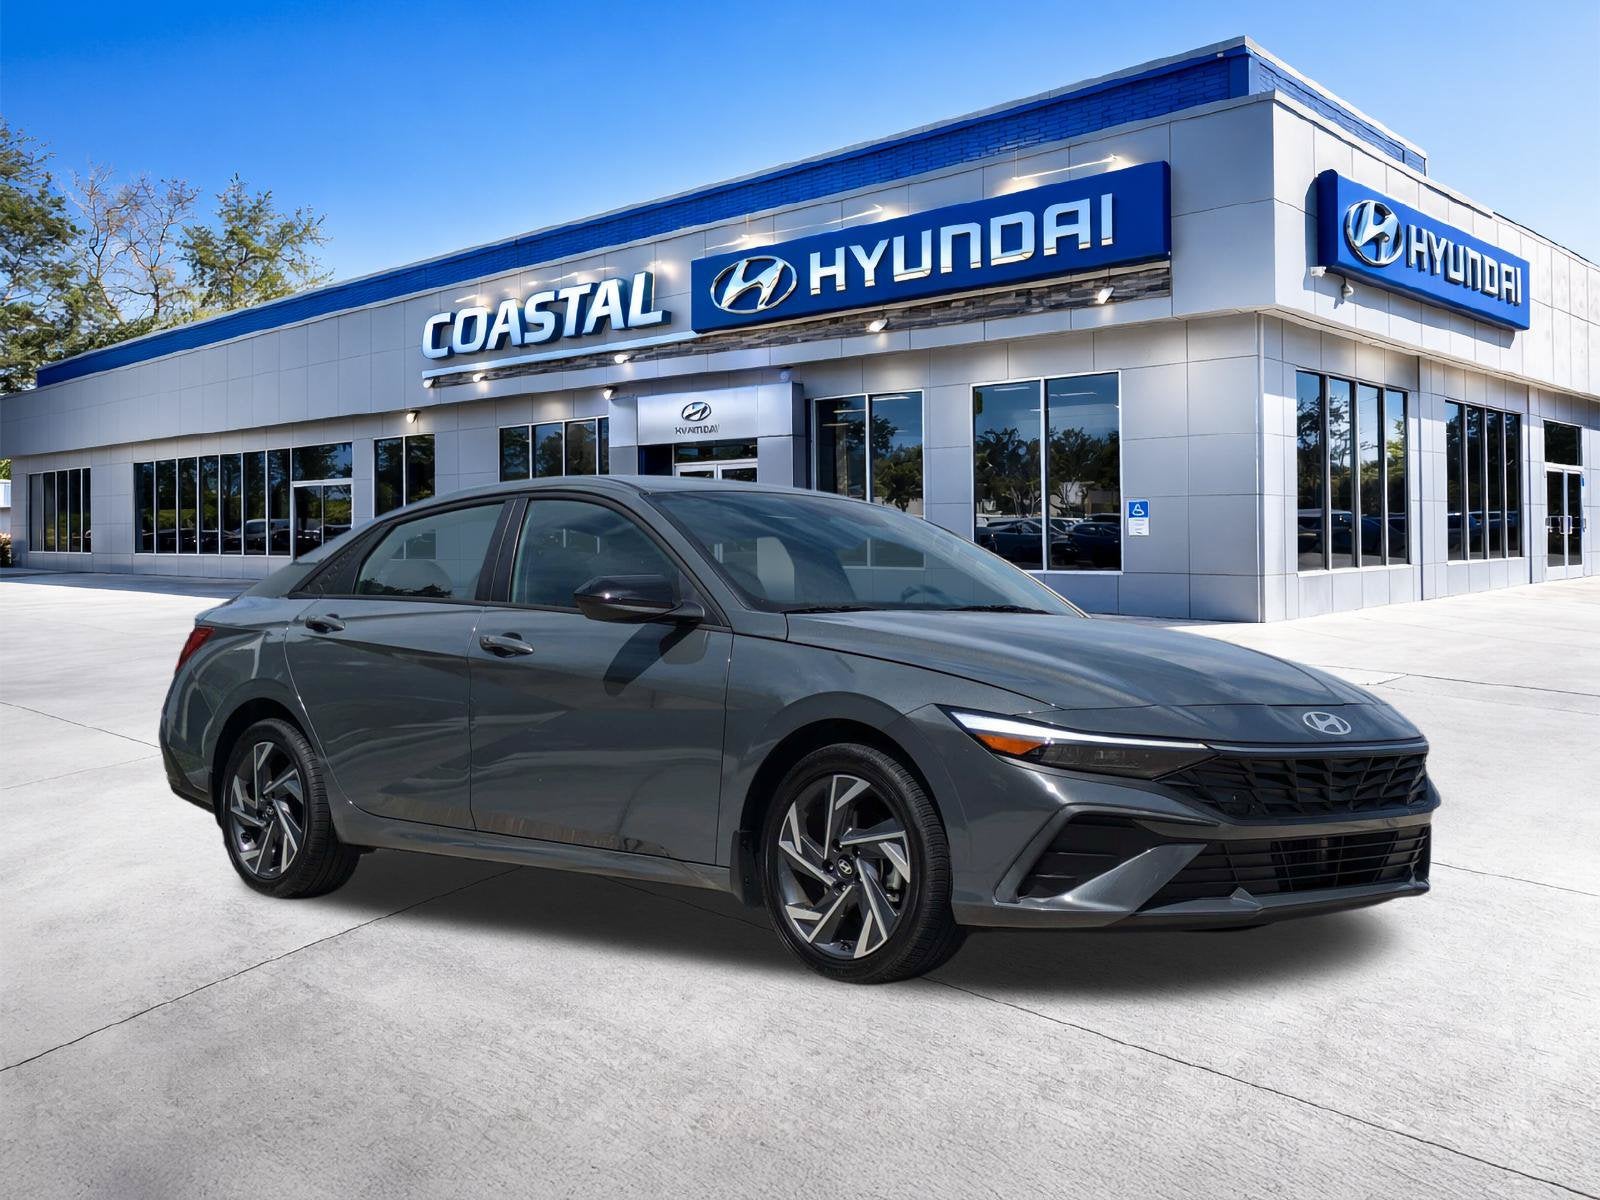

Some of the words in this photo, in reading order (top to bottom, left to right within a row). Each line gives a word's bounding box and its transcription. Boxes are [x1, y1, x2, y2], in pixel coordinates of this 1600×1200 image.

[809, 192, 1114, 296] HYUNDAI
[1407, 224, 1522, 306] HYUNDAI
[421, 271, 671, 360] COASTAL
